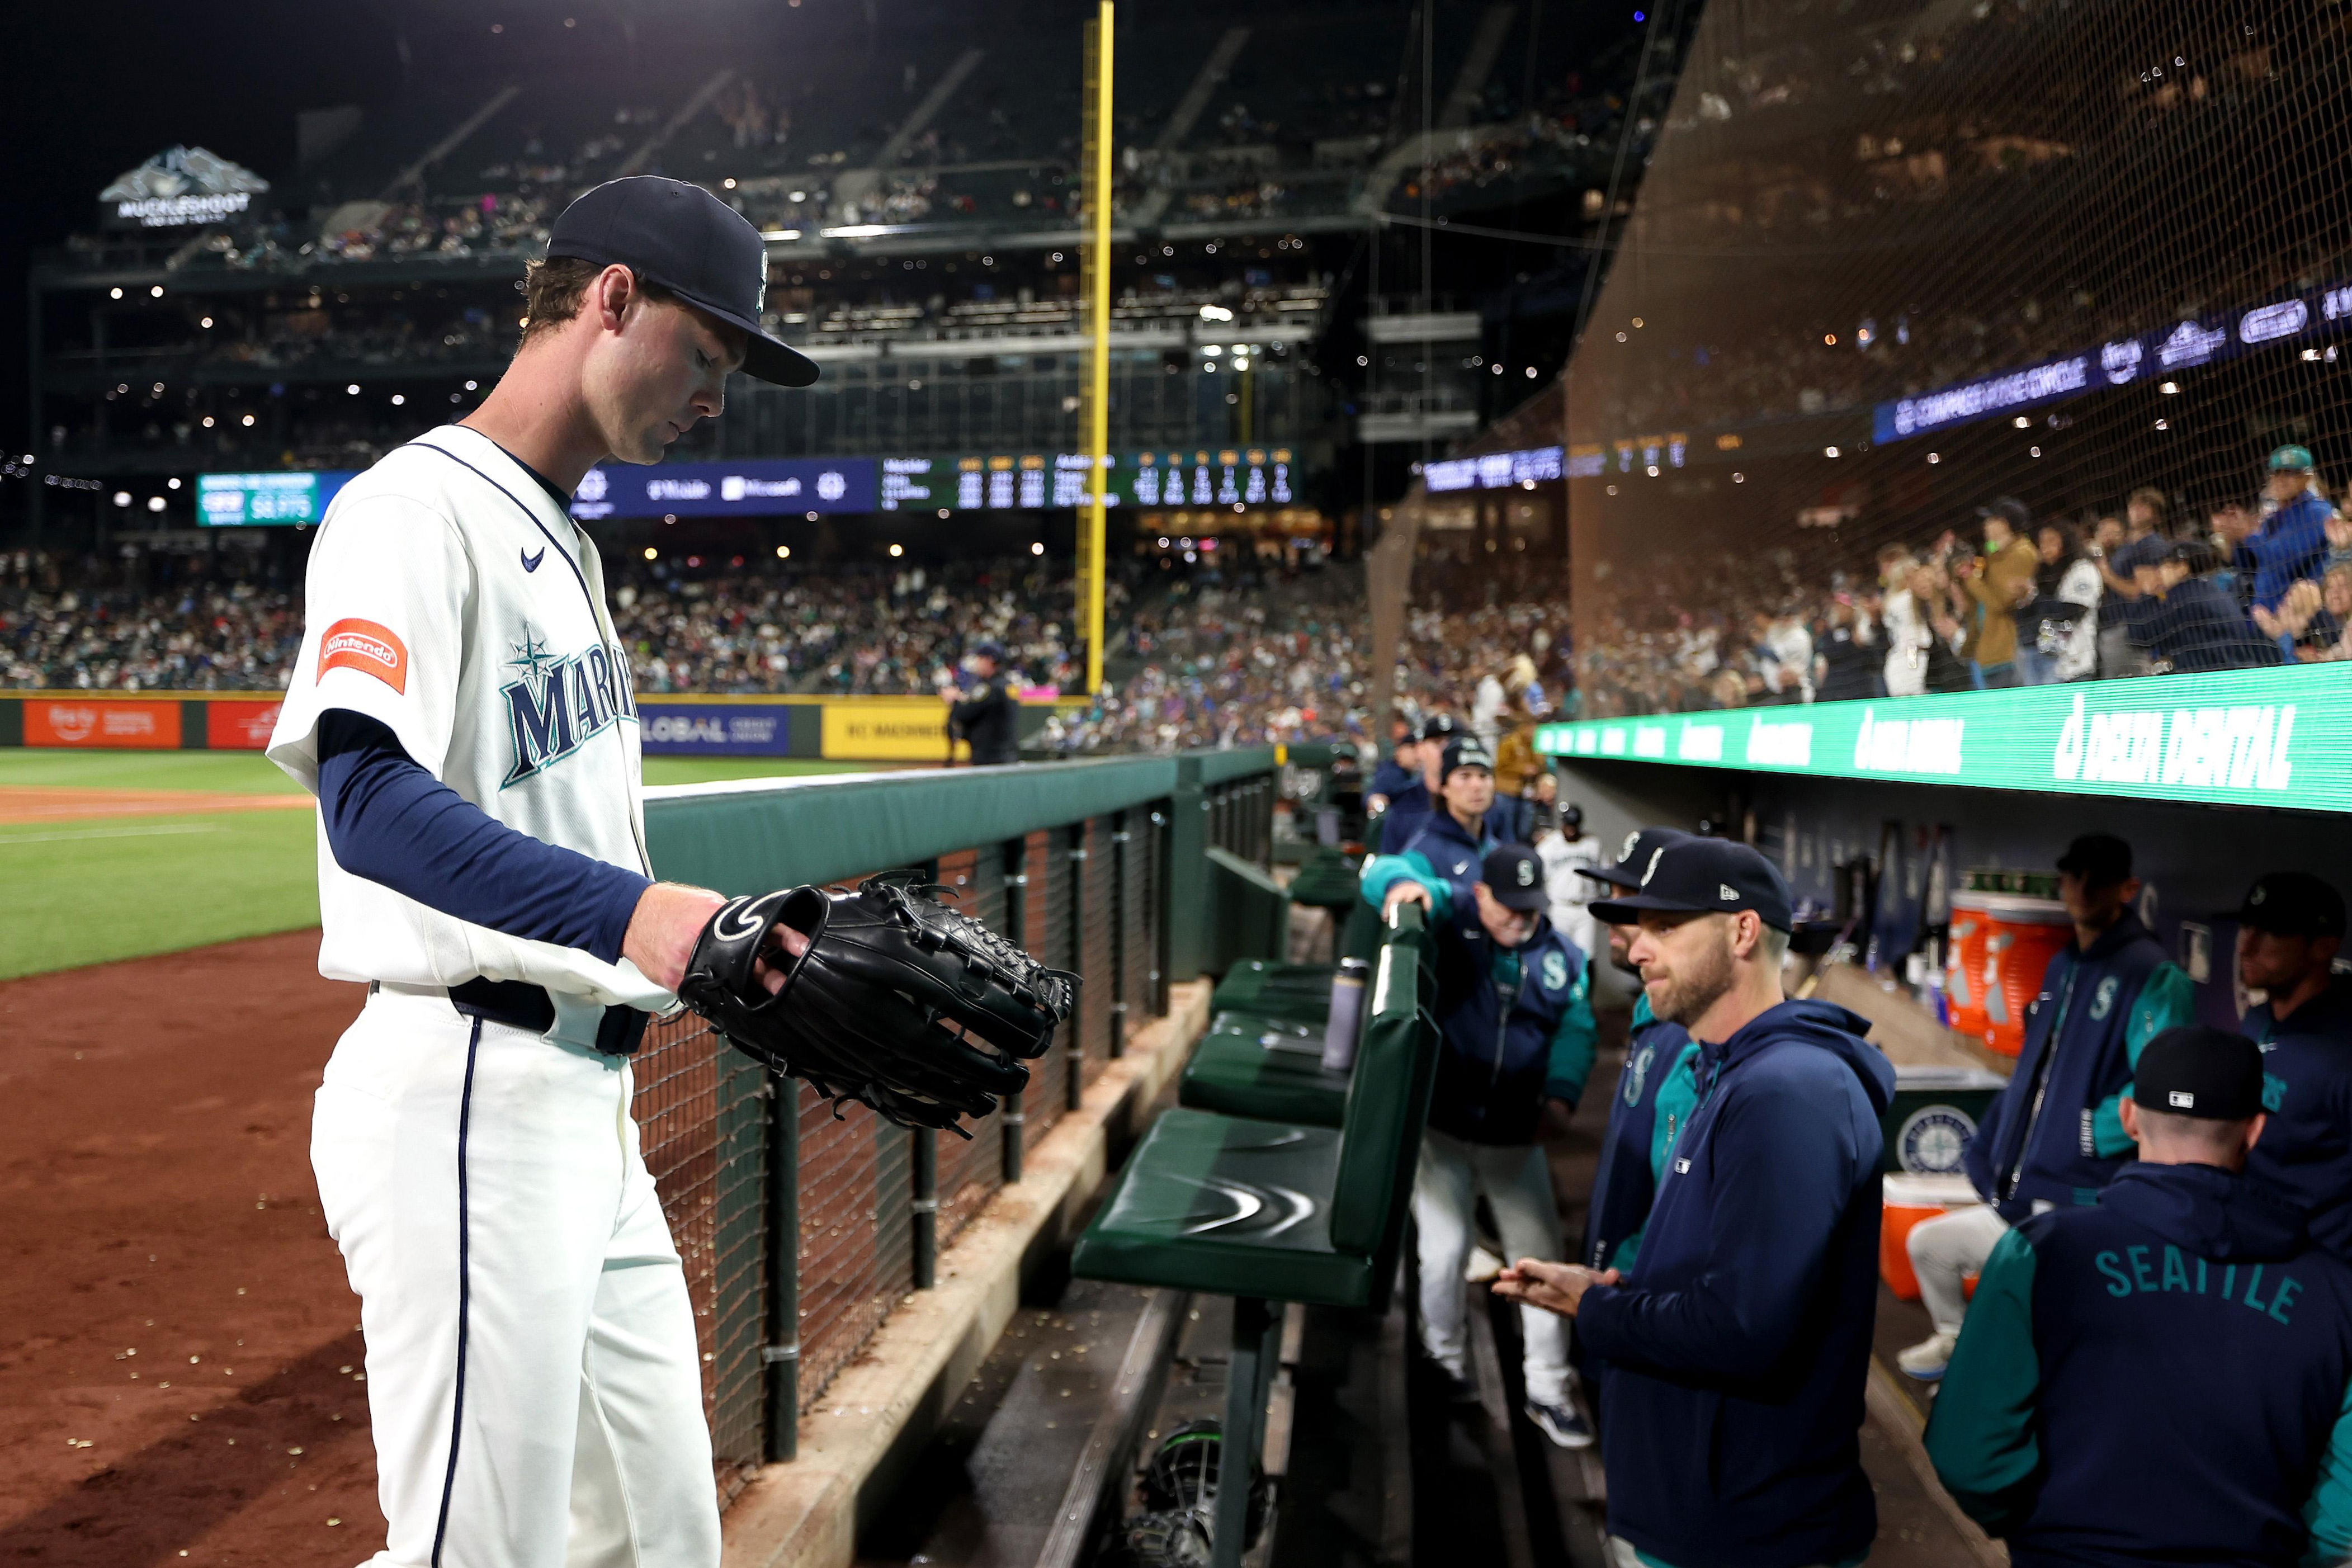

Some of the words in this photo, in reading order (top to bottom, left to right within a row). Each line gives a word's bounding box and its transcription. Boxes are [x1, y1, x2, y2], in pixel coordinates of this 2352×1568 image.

[326, 637, 391, 662] Nintendo
[499, 644, 640, 791] MARI
[639, 715, 728, 743] LOBAL
[1517, 859, 1535, 886] S
[1542, 951, 1567, 991] S
[2090, 976, 2120, 1022] S
